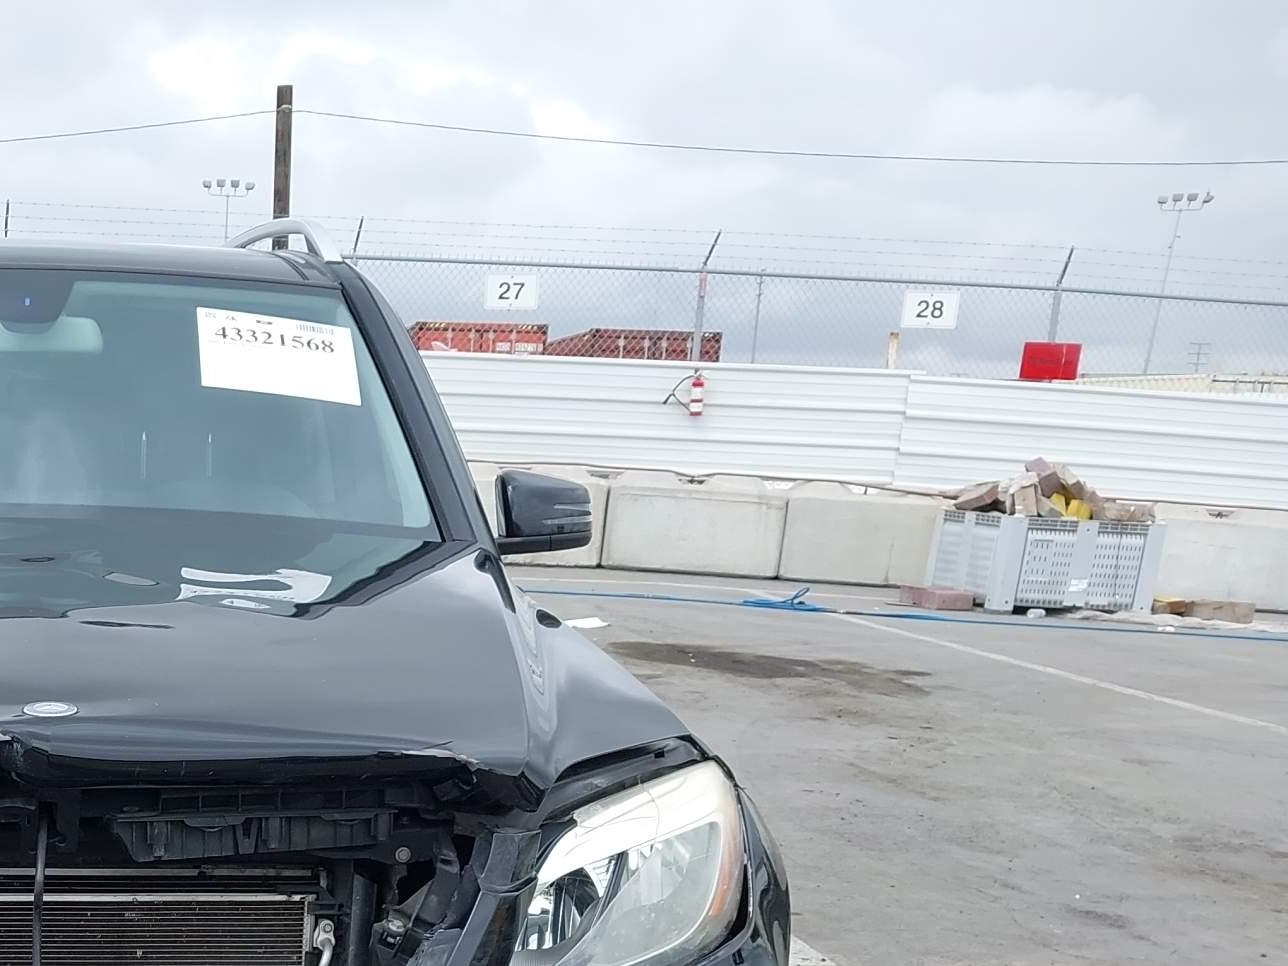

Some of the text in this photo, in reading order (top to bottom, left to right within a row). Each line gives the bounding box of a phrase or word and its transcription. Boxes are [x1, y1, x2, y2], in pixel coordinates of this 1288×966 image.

[498, 282, 525, 301] 27
[916, 300, 944, 319] 28
[215, 325, 335, 354] 43321568
